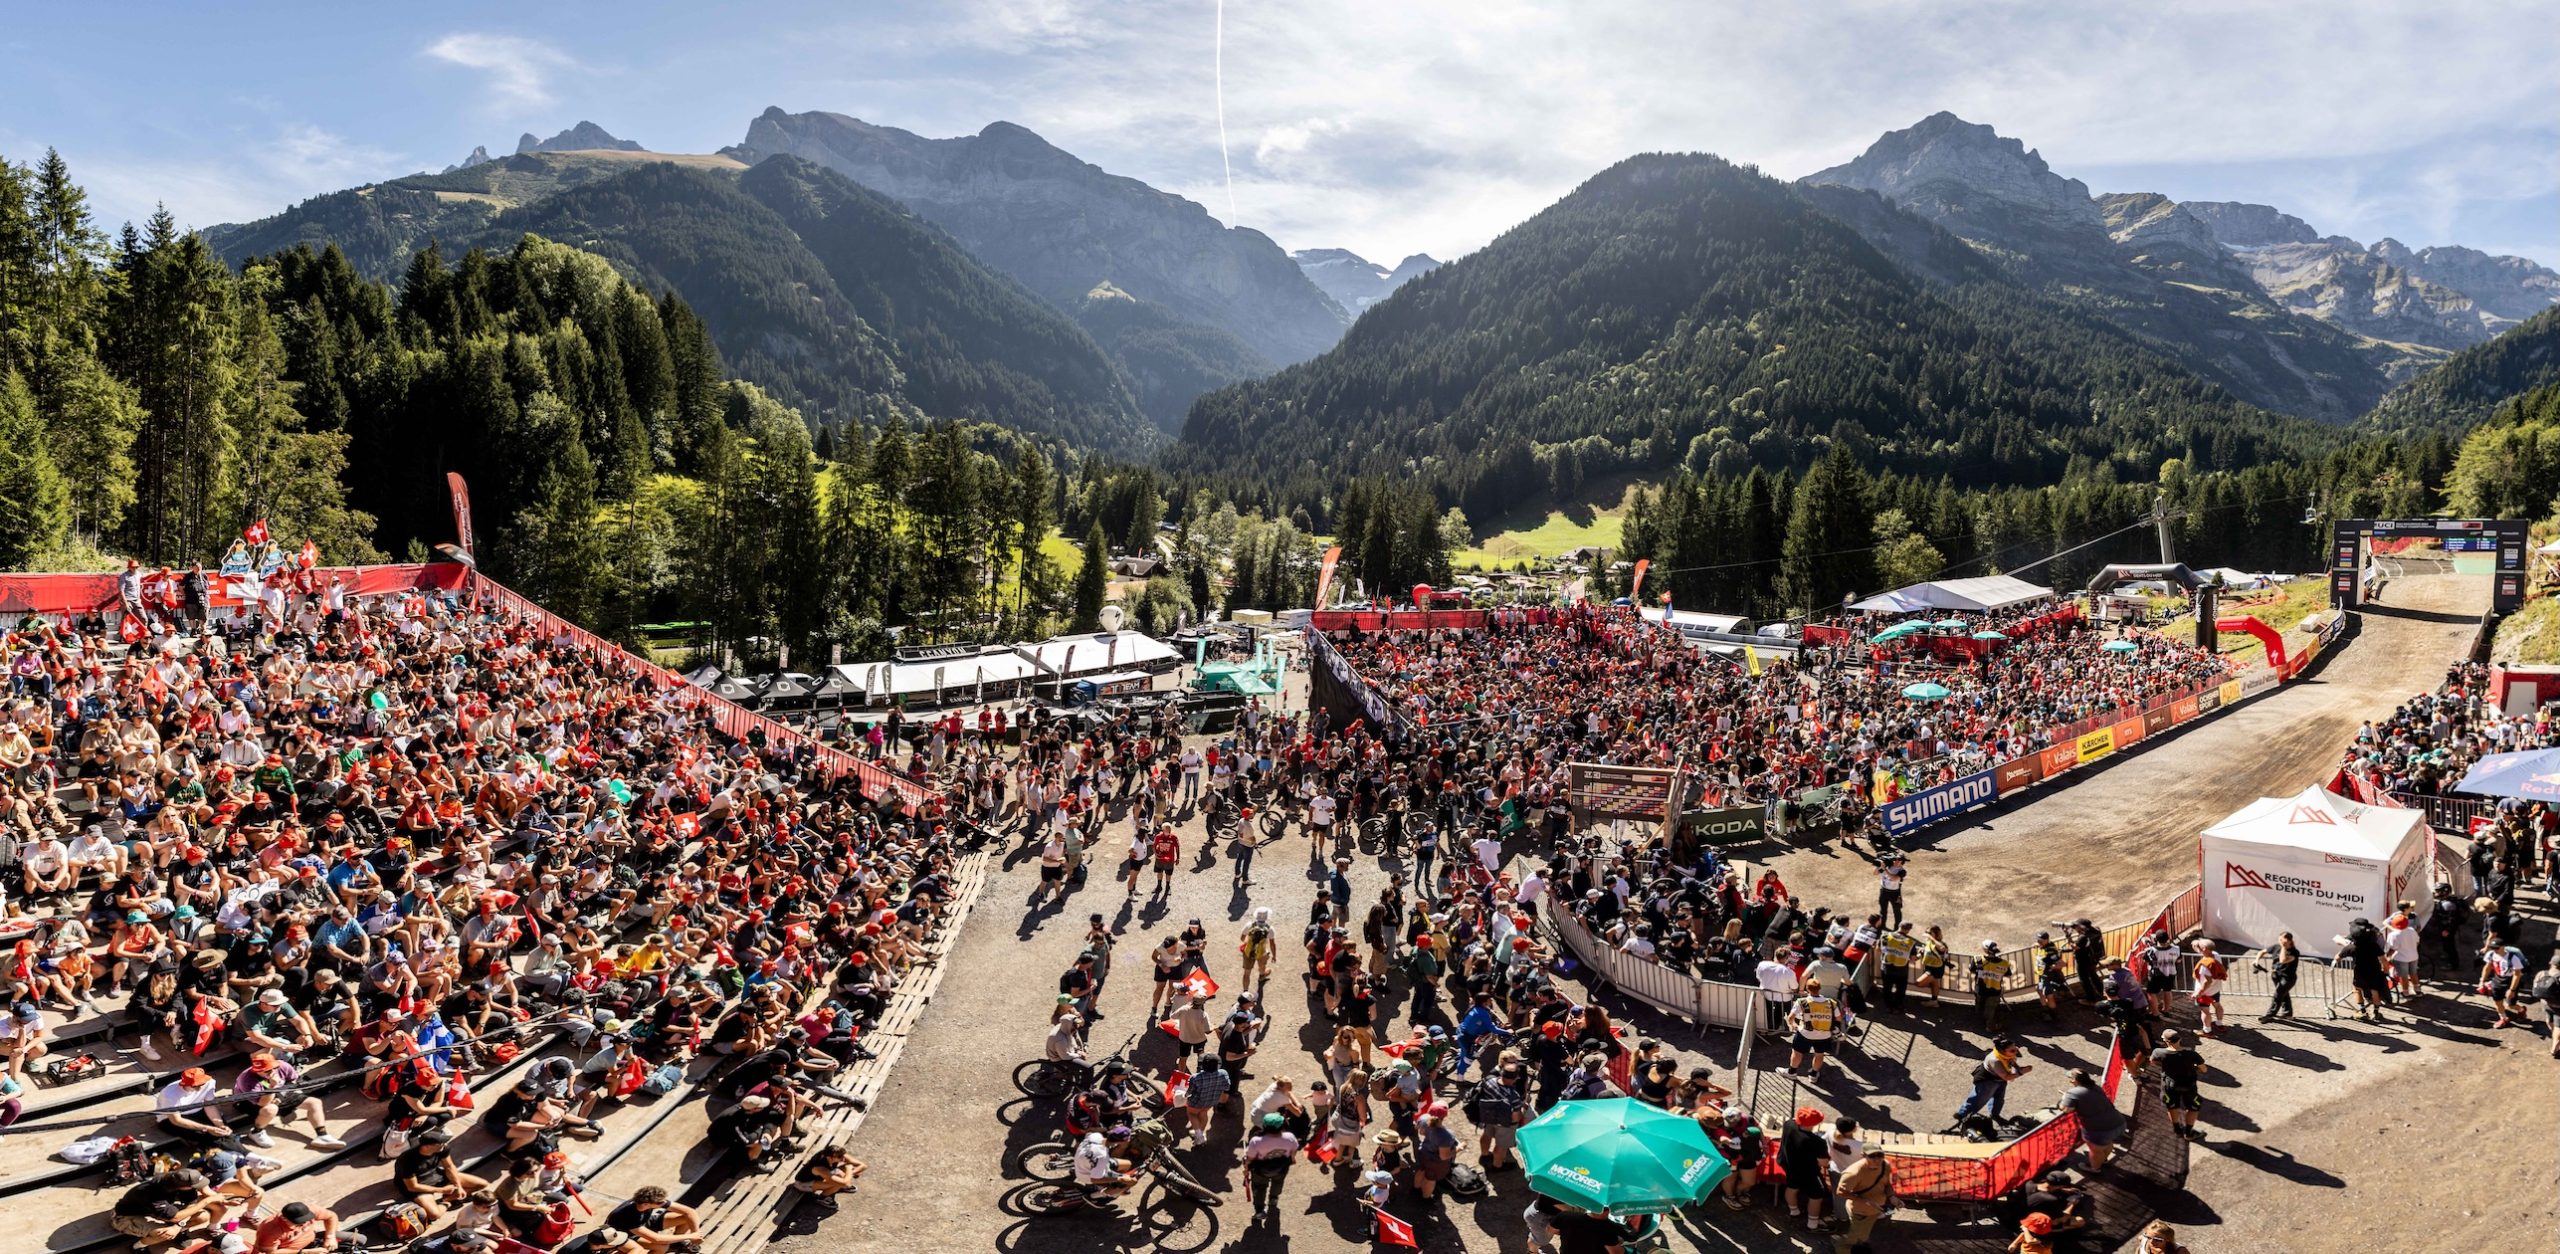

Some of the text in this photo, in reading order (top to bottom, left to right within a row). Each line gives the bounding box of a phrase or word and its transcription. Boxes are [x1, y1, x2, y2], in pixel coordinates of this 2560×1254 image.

[2179, 701, 2197, 716] Valais
[2053, 746, 2077, 765] Valais
[1889, 776, 1992, 830] SHIMANO
[2264, 873, 2311, 887] REGION
[2275, 885, 2364, 904] DENTS DU MIDI
[1550, 1163, 1602, 1191] MOTOREX
[1680, 1154, 1710, 1184] MOTOREX
